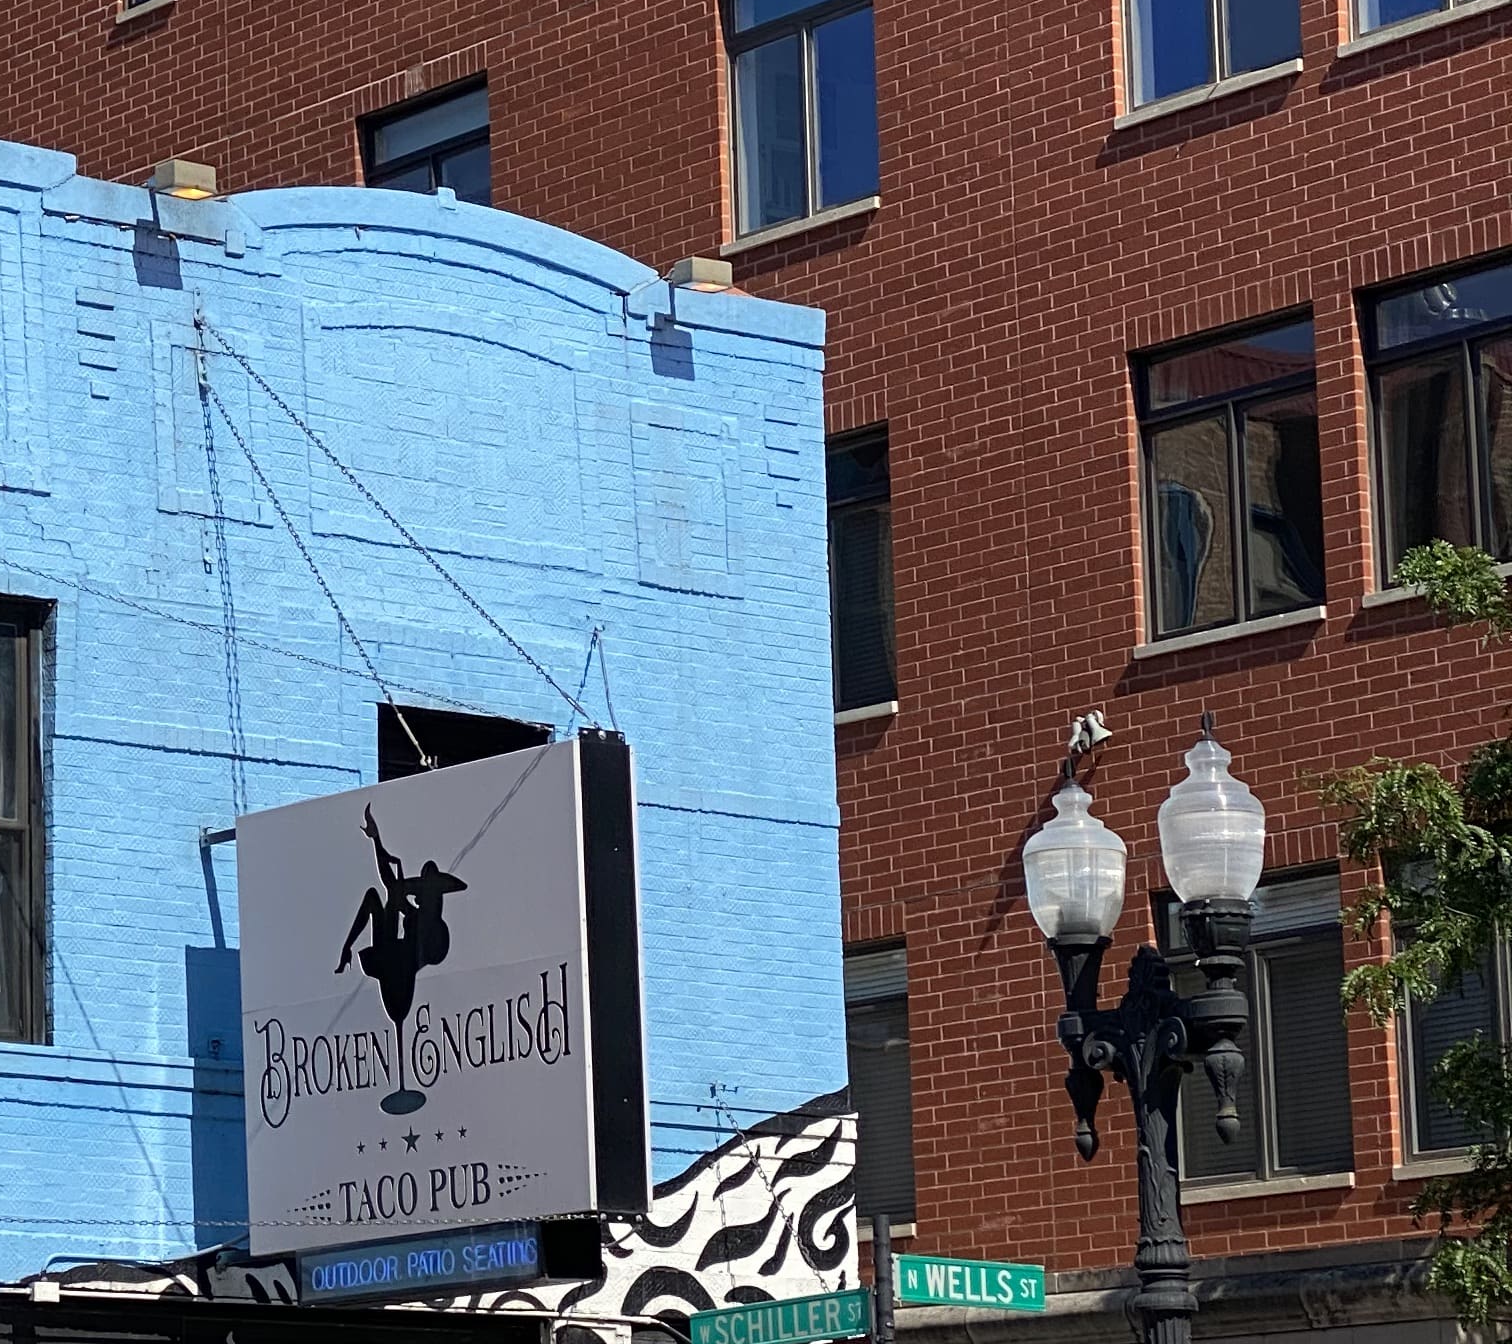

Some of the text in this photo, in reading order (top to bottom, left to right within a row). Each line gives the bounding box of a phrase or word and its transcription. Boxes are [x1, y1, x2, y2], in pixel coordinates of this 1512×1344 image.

[254, 962, 571, 1128] BROKEN ENGLISH
[339, 1161, 491, 1223] TACO PUB
[311, 1237, 538, 1292] OUTDOOR PATIO SEATING
[908, 1263, 1037, 1304] N WELLS ST
[699, 1324, 711, 1344] W
[847, 1302, 862, 1322] ST
